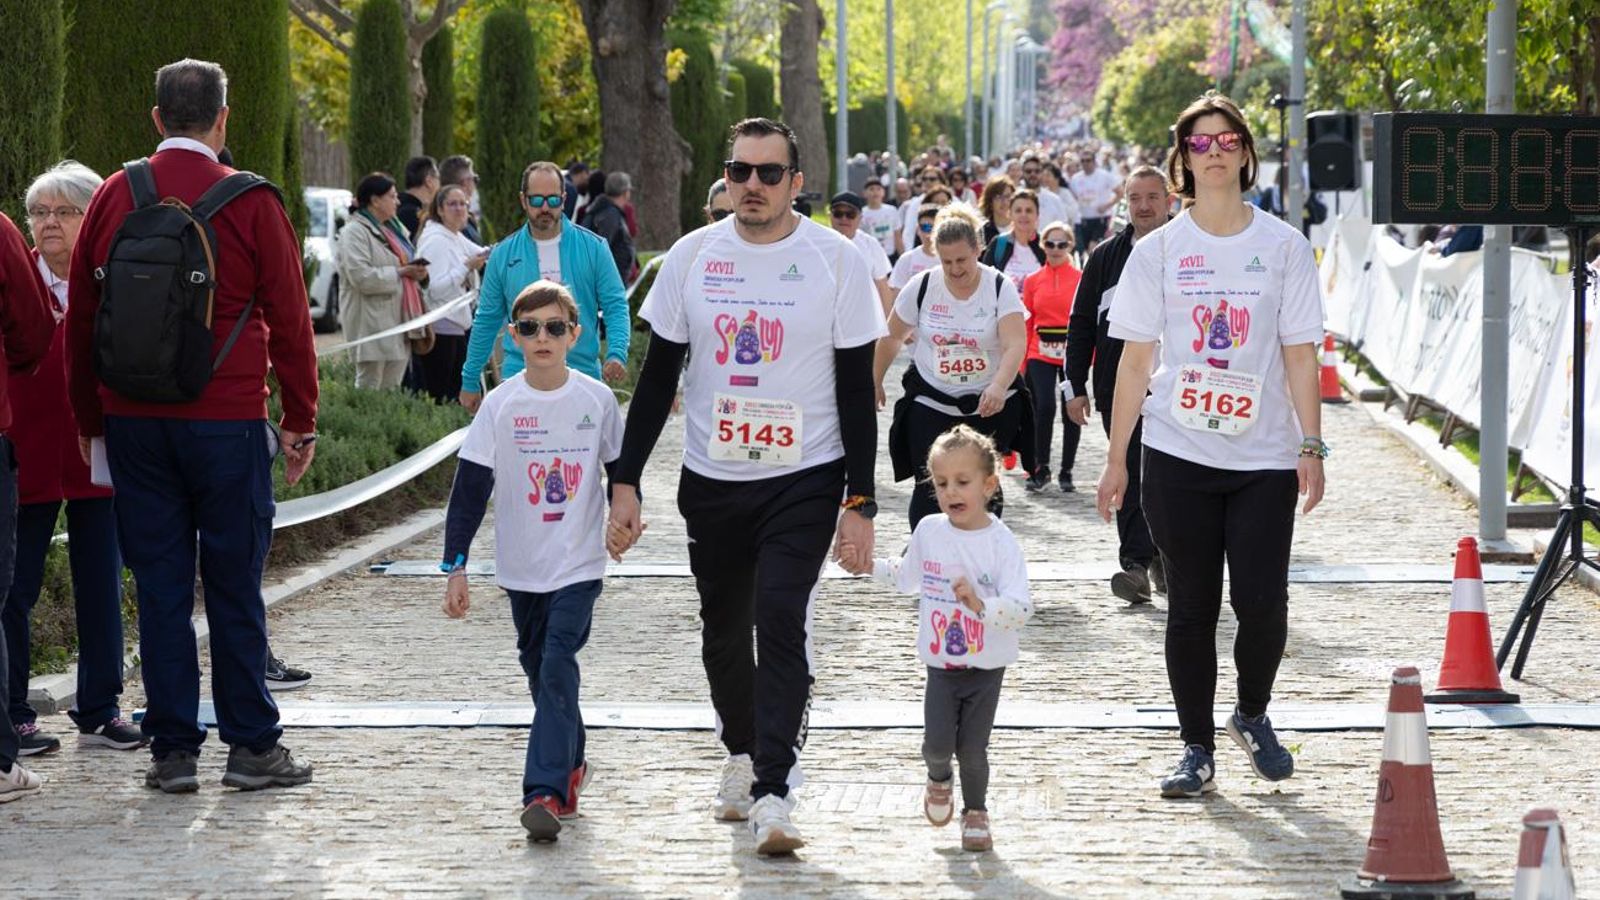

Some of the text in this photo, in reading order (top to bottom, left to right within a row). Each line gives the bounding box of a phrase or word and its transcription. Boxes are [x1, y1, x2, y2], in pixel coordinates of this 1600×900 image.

[704, 260, 735, 275] XXVII
[1179, 255, 1205, 268] XXVII
[940, 358, 986, 374] 5483
[1180, 387, 1253, 418] 5162
[513, 416, 538, 428] XXVII
[718, 419, 795, 447] 5143
